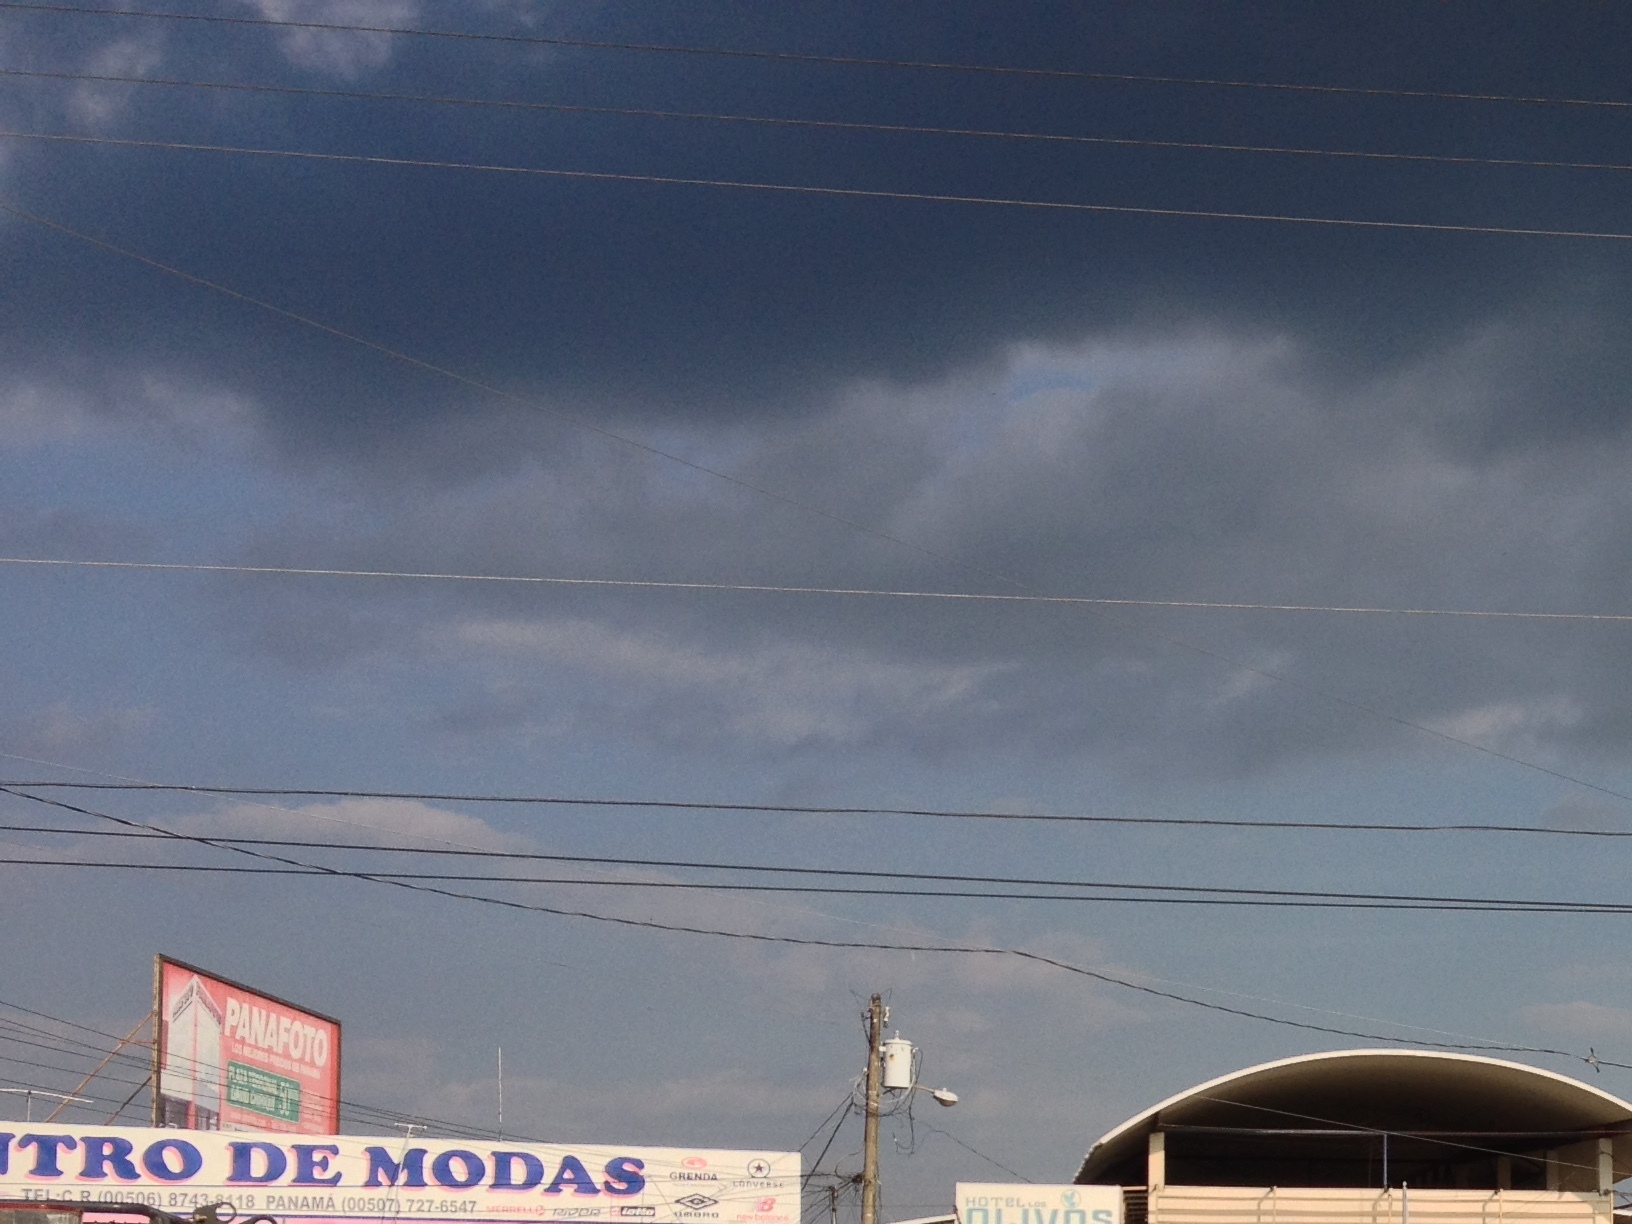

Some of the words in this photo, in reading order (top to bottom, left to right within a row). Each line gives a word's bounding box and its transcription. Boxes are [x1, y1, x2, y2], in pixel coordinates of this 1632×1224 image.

[224, 997, 328, 1067] PANAFOTO
[227, 1141, 343, 1187] DE
[364, 1146, 646, 1196] MODAS
[99, 1190, 163, 1207] (00506)
[168, 1192, 255, 1209] 8743-8118
[266, 1193, 336, 1210] PANAMÁ
[342, 1197, 401, 1214] (00507)
[407, 1199, 477, 1214] 727-6547
[965, 1197, 1025, 1208] HOTEL
